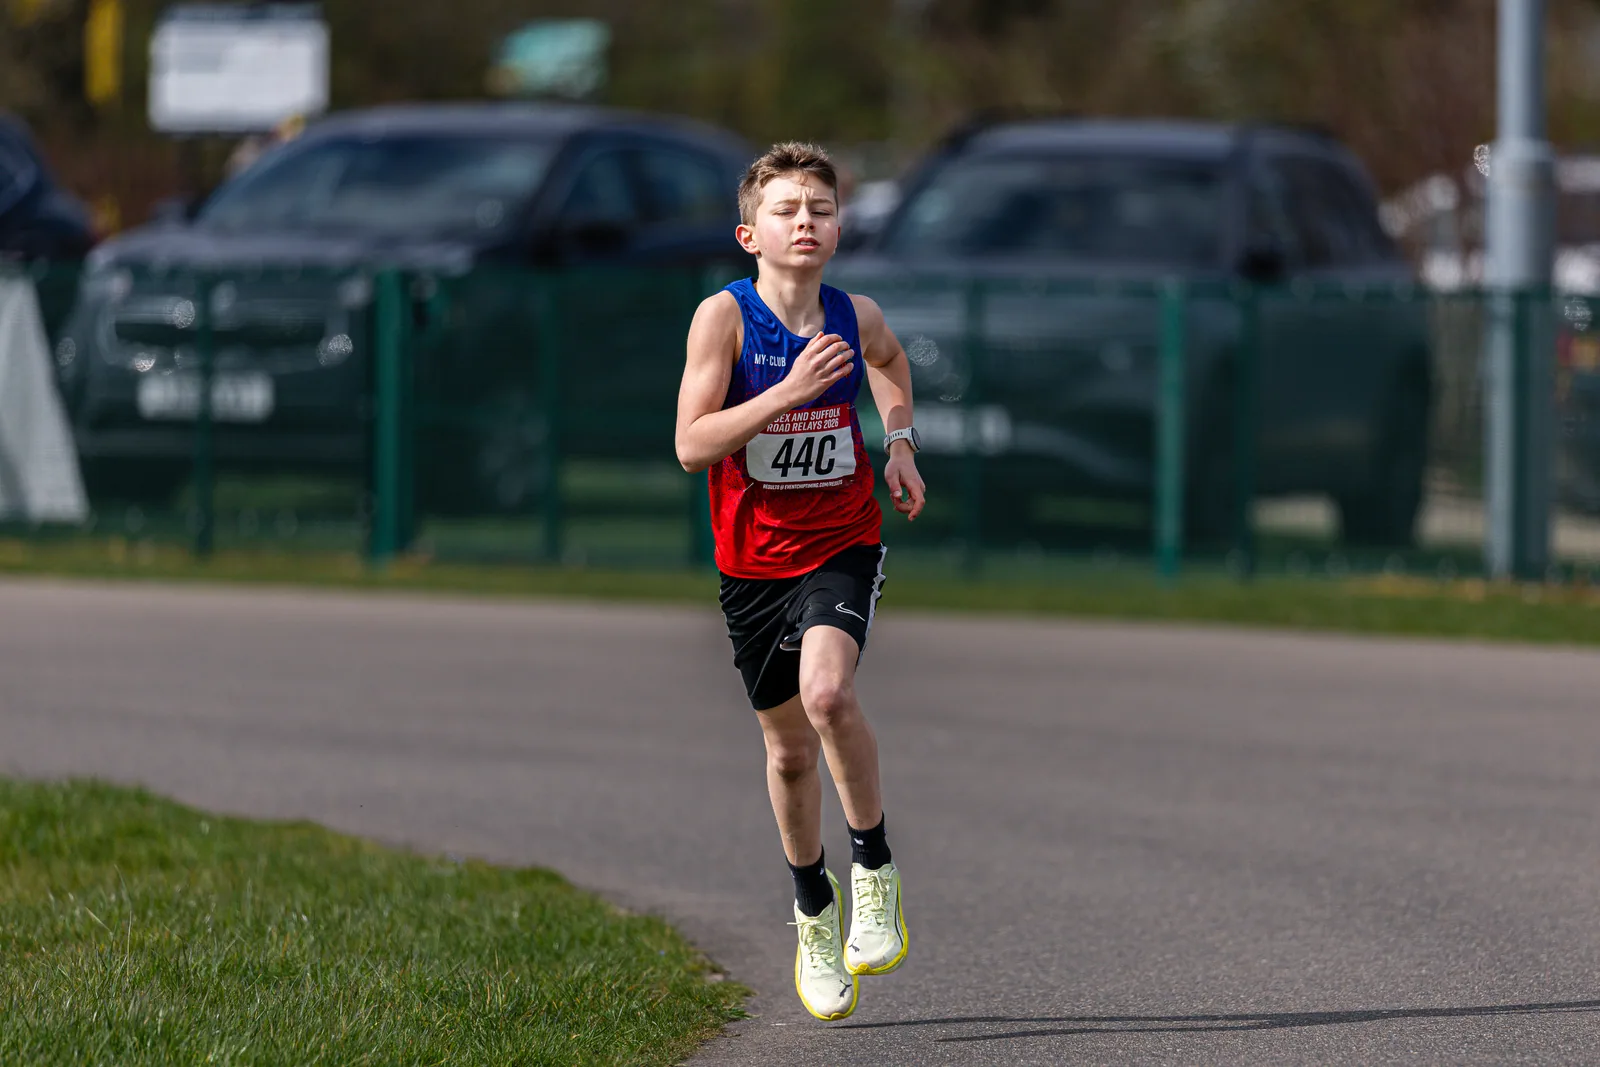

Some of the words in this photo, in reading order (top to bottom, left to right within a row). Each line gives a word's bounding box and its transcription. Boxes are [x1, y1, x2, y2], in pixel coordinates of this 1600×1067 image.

[791, 411, 809, 422] AND
[810, 407, 841, 421] SUFFOLK
[767, 423, 791, 432] ROAD
[792, 420, 823, 432] RELAYS
[823, 418, 839, 429] 2026
[770, 434, 837, 478] 44C
